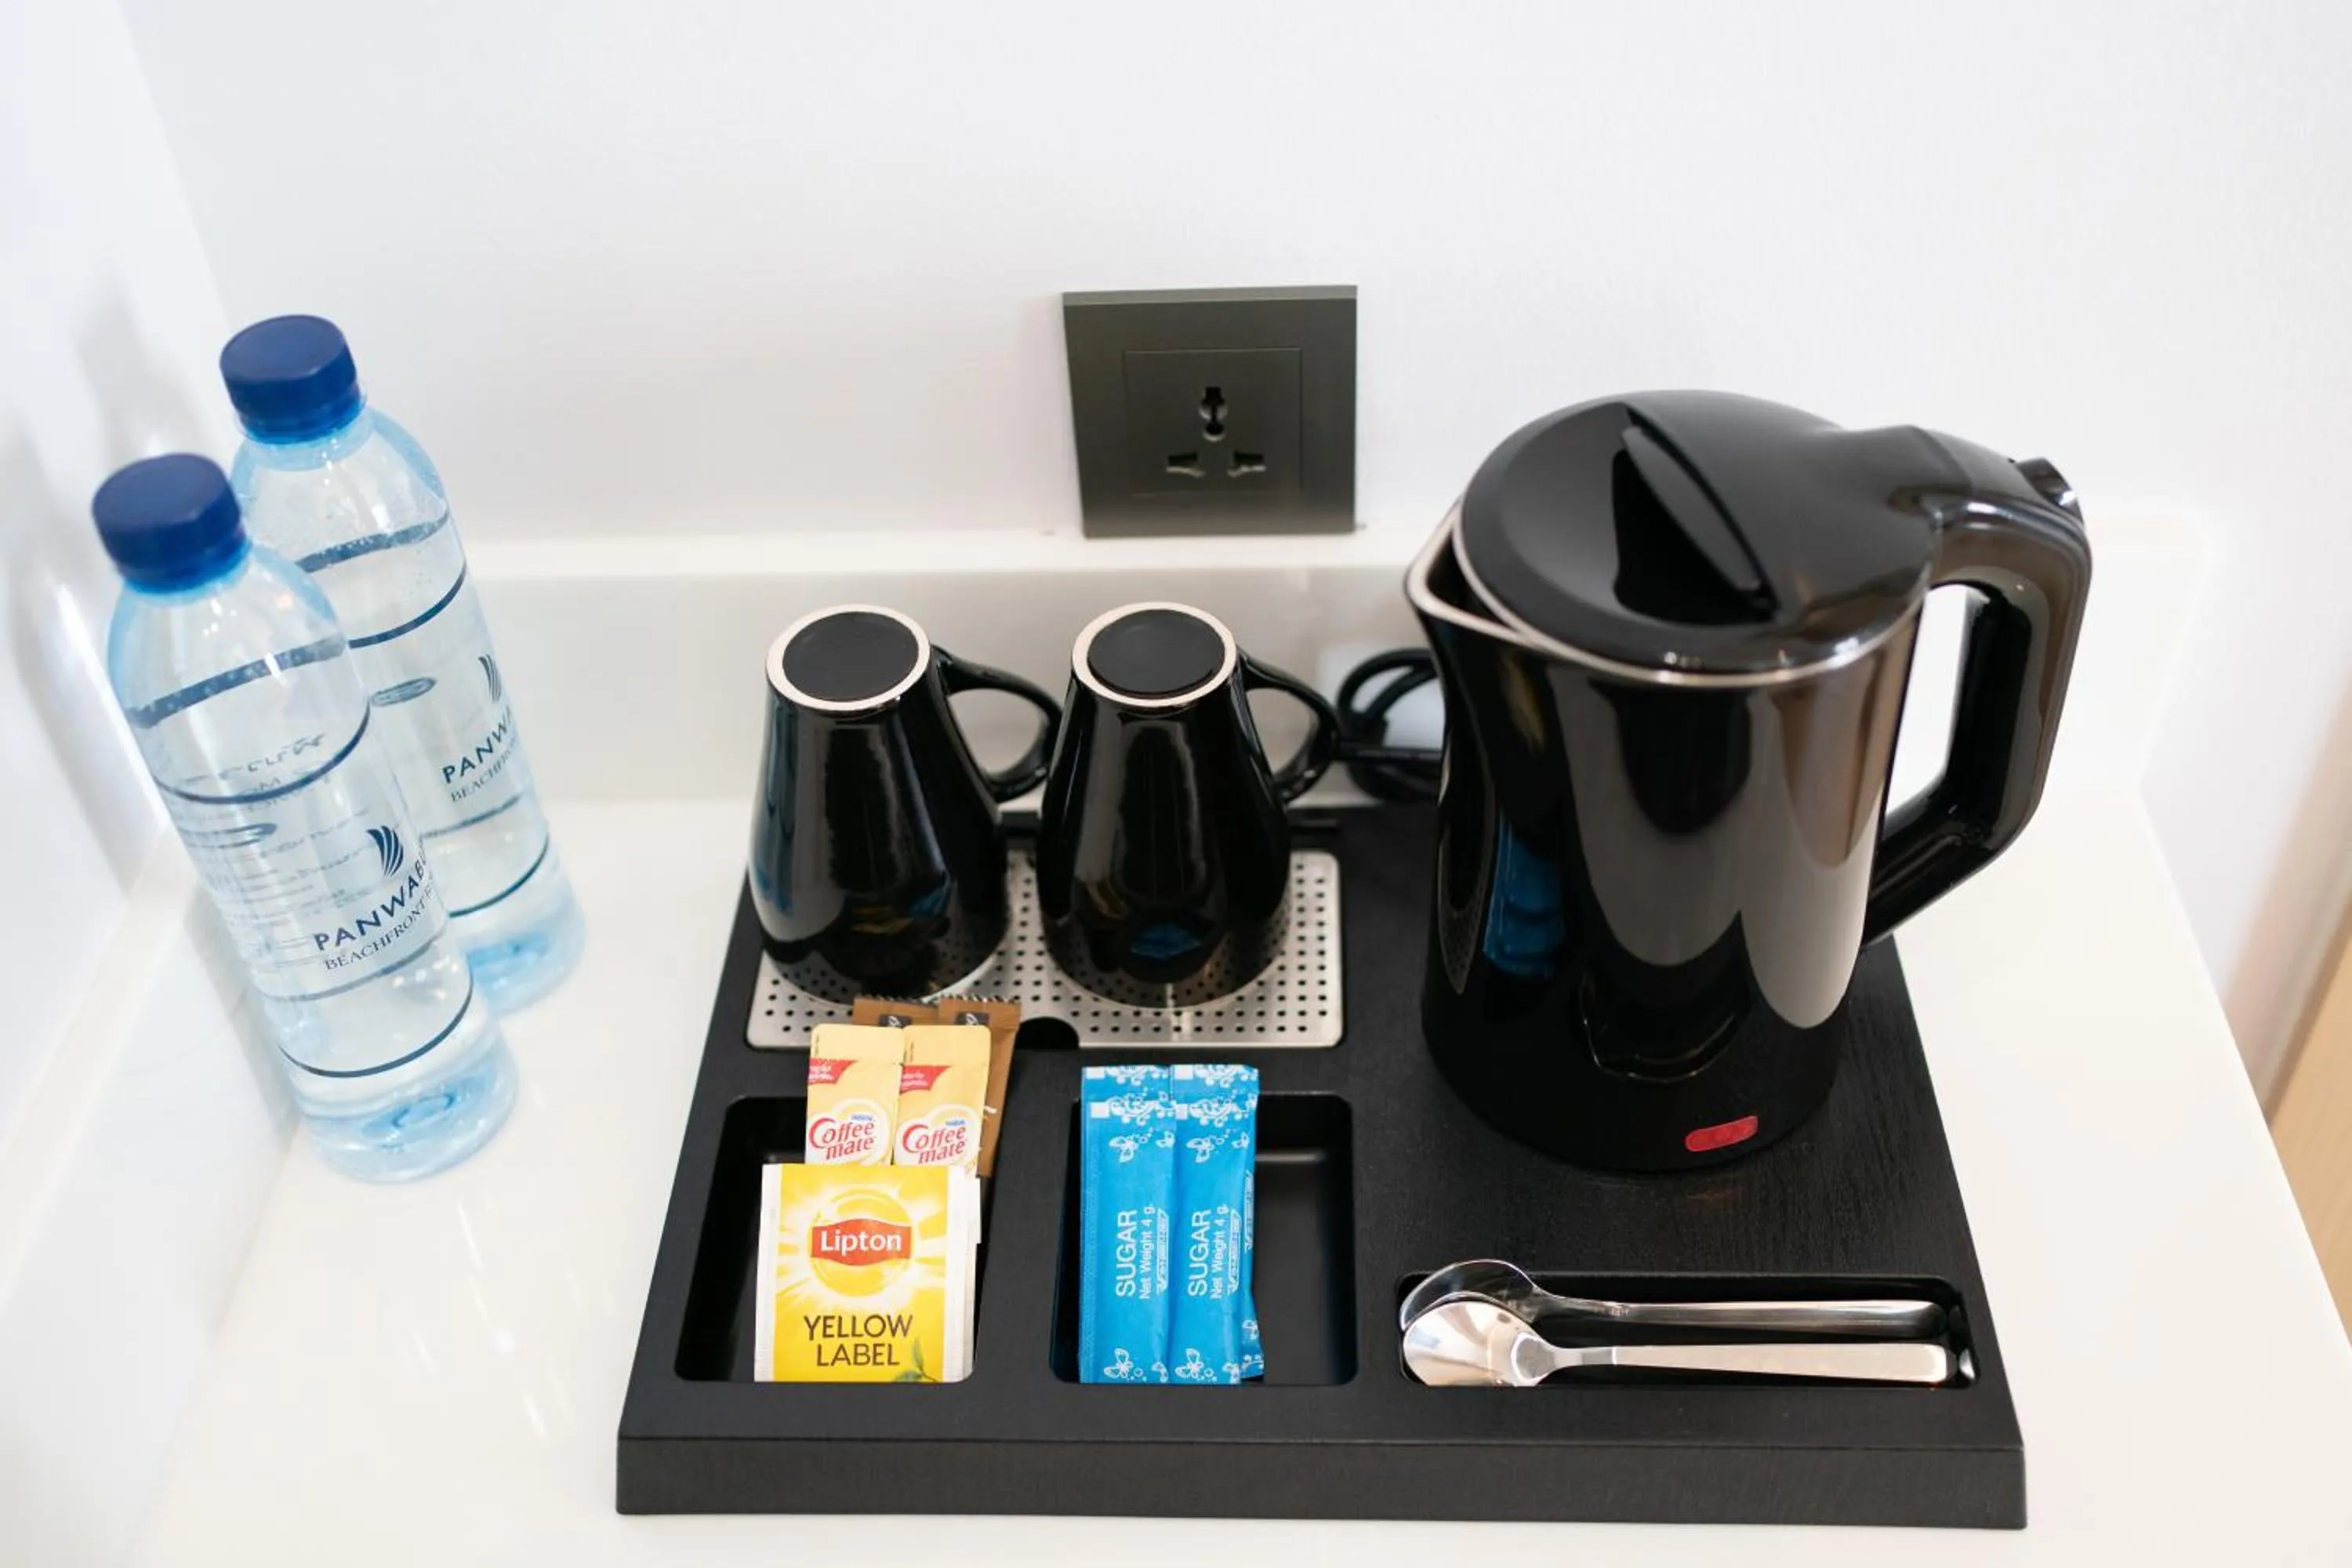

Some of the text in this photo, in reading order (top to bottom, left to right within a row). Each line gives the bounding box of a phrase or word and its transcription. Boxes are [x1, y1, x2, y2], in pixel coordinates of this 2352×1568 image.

[324, 895, 426, 971] BEACHFRONT
[808, 1117, 875, 1149] Coffee
[902, 1123, 967, 1154] Coffee
[826, 1136, 874, 1160] mate
[918, 1140, 966, 1164] mate
[1142, 1218, 1152, 1227] 4
[1214, 1218, 1225, 1227] 4
[820, 1229, 902, 1256] Lipton
[1116, 1210, 1138, 1298] SUGAR
[1140, 1230, 1154, 1273] Weight
[1188, 1210, 1211, 1297] SUGAR
[1211, 1230, 1228, 1273] Weight
[1139, 1277, 1152, 1299] Net
[1210, 1277, 1223, 1299] Net
[803, 1313, 913, 1341] YELLOW
[816, 1342, 901, 1367] LABEL
